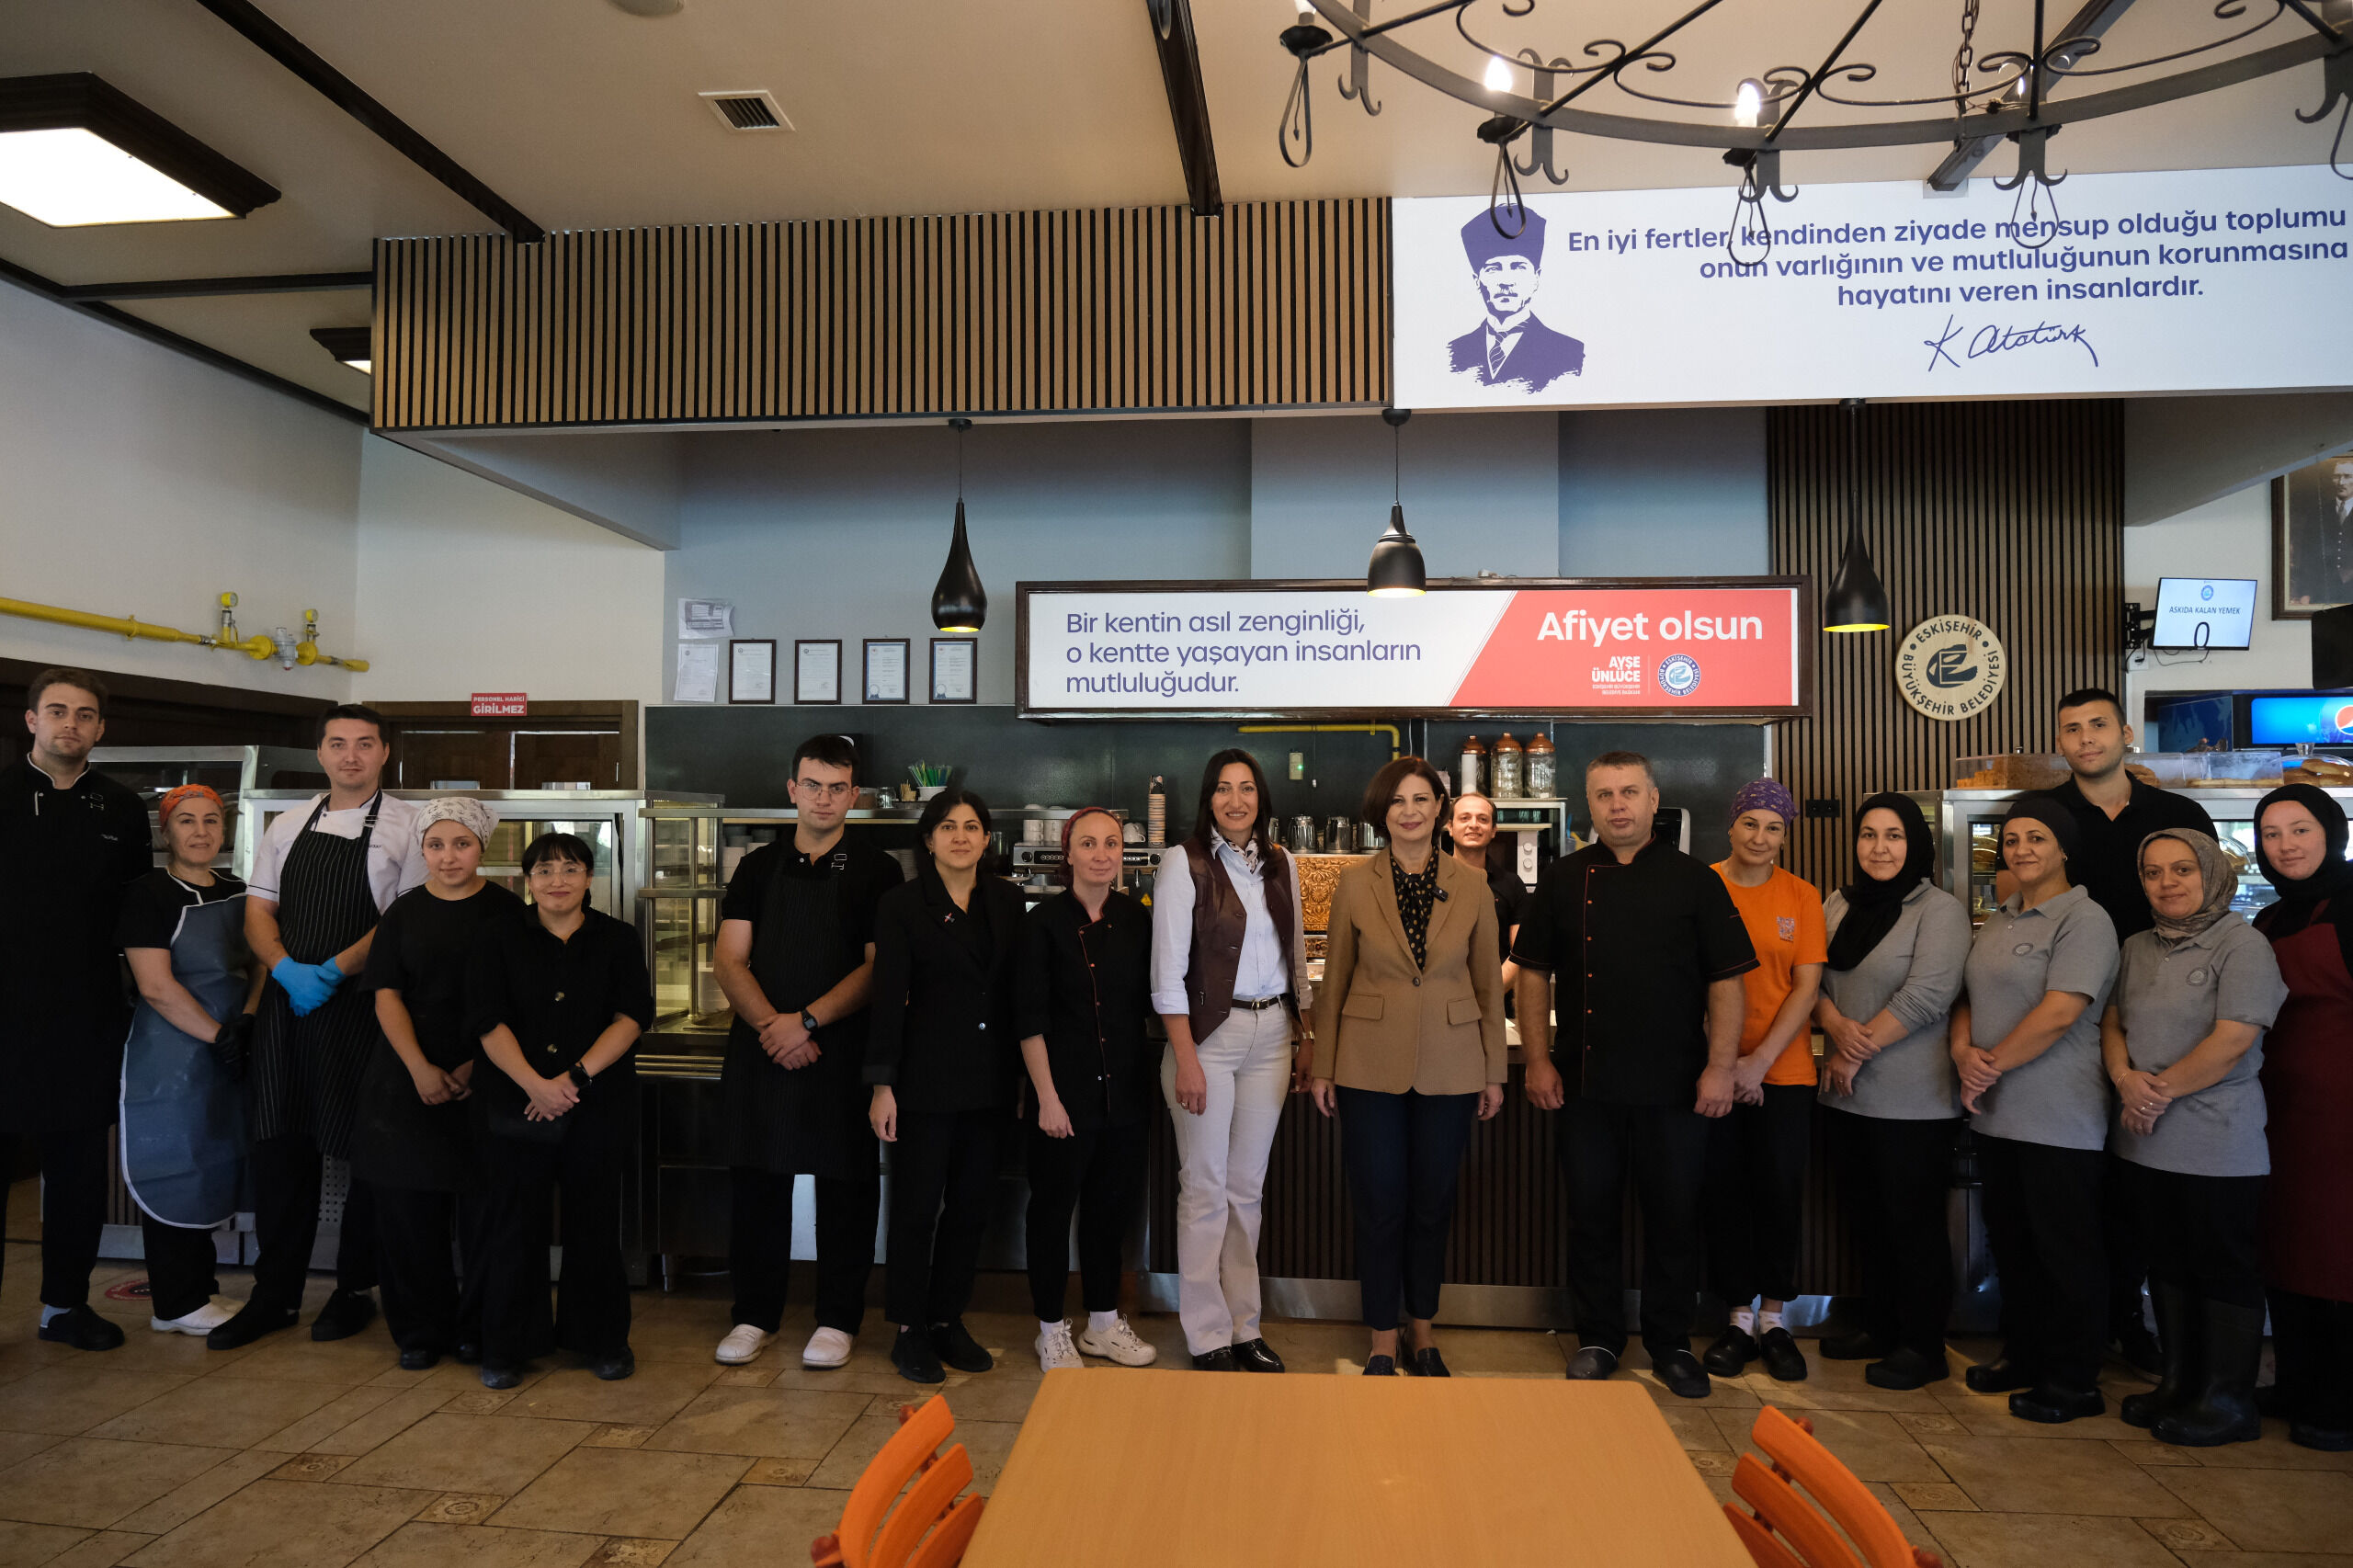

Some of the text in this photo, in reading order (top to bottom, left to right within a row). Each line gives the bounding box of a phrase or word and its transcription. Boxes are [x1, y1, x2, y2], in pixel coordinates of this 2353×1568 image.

[1568, 232, 1599, 252] En
[1608, 229, 1637, 255] iyi
[1741, 223, 1886, 246] kendinden
[1894, 219, 1986, 245] ziyade
[1995, 219, 2109, 240] mensup
[2118, 209, 2217, 237] olduğu
[2225, 207, 2347, 234] toplumu
[1699, 242, 2348, 279] onun varlığının ve mutluluğunun korunmasına
[1838, 276, 2204, 310] hayatını veren insanlardır.
[1066, 608, 1366, 637] Bir kentin asıl zenginliği,
[2169, 606, 2193, 614] ASKIDA
[2219, 607, 2242, 615] YEMEK
[1536, 609, 1763, 648] Afiyet olsun
[1915, 619, 1983, 643] ESKİŞEHİR
[1066, 640, 1421, 667] o kentte yaşayan insanların
[1608, 655, 1641, 670] AYŞE
[1066, 670, 1239, 698] mutluluğudur.
[1591, 667, 1641, 683] ÜNLÜCE
[1902, 650, 2000, 715] BÜYÜKŞEHİR BELEDİYESİ
[472, 702, 525, 714] GİRİLMEZ
